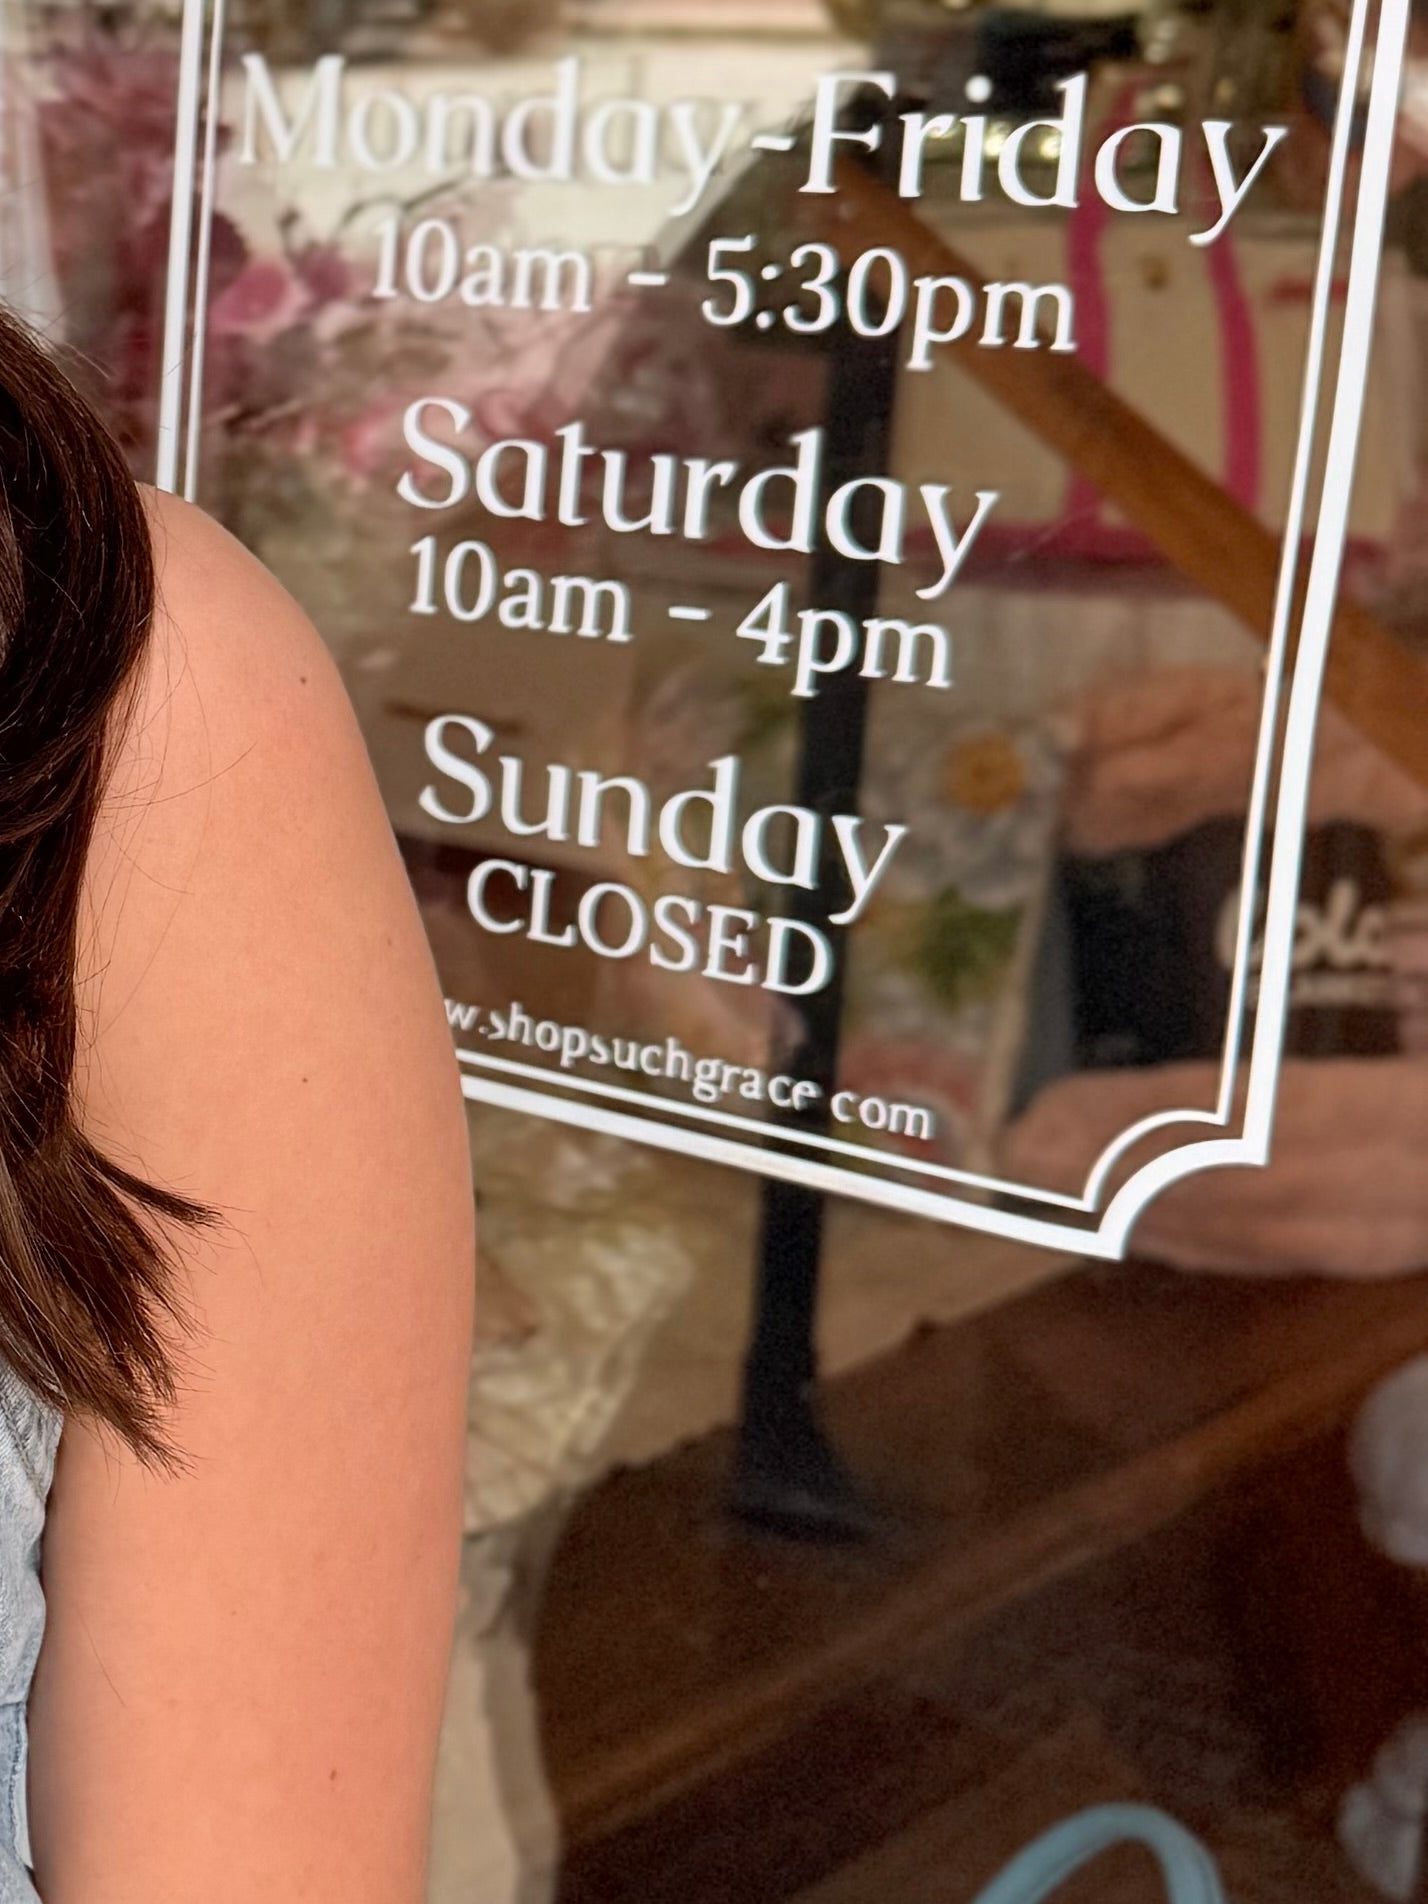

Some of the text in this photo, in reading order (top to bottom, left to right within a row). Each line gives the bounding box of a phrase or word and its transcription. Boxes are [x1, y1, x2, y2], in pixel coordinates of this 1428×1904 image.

[372, 219, 592, 313] 10am
[700, 237, 1078, 371] 5:30pm
[396, 396, 1000, 600] Saturday
[407, 536, 634, 644] 10am
[735, 583, 953, 695] 4pm
[418, 714, 910, 926] Sunday
[465, 860, 834, 996] CLOSED
